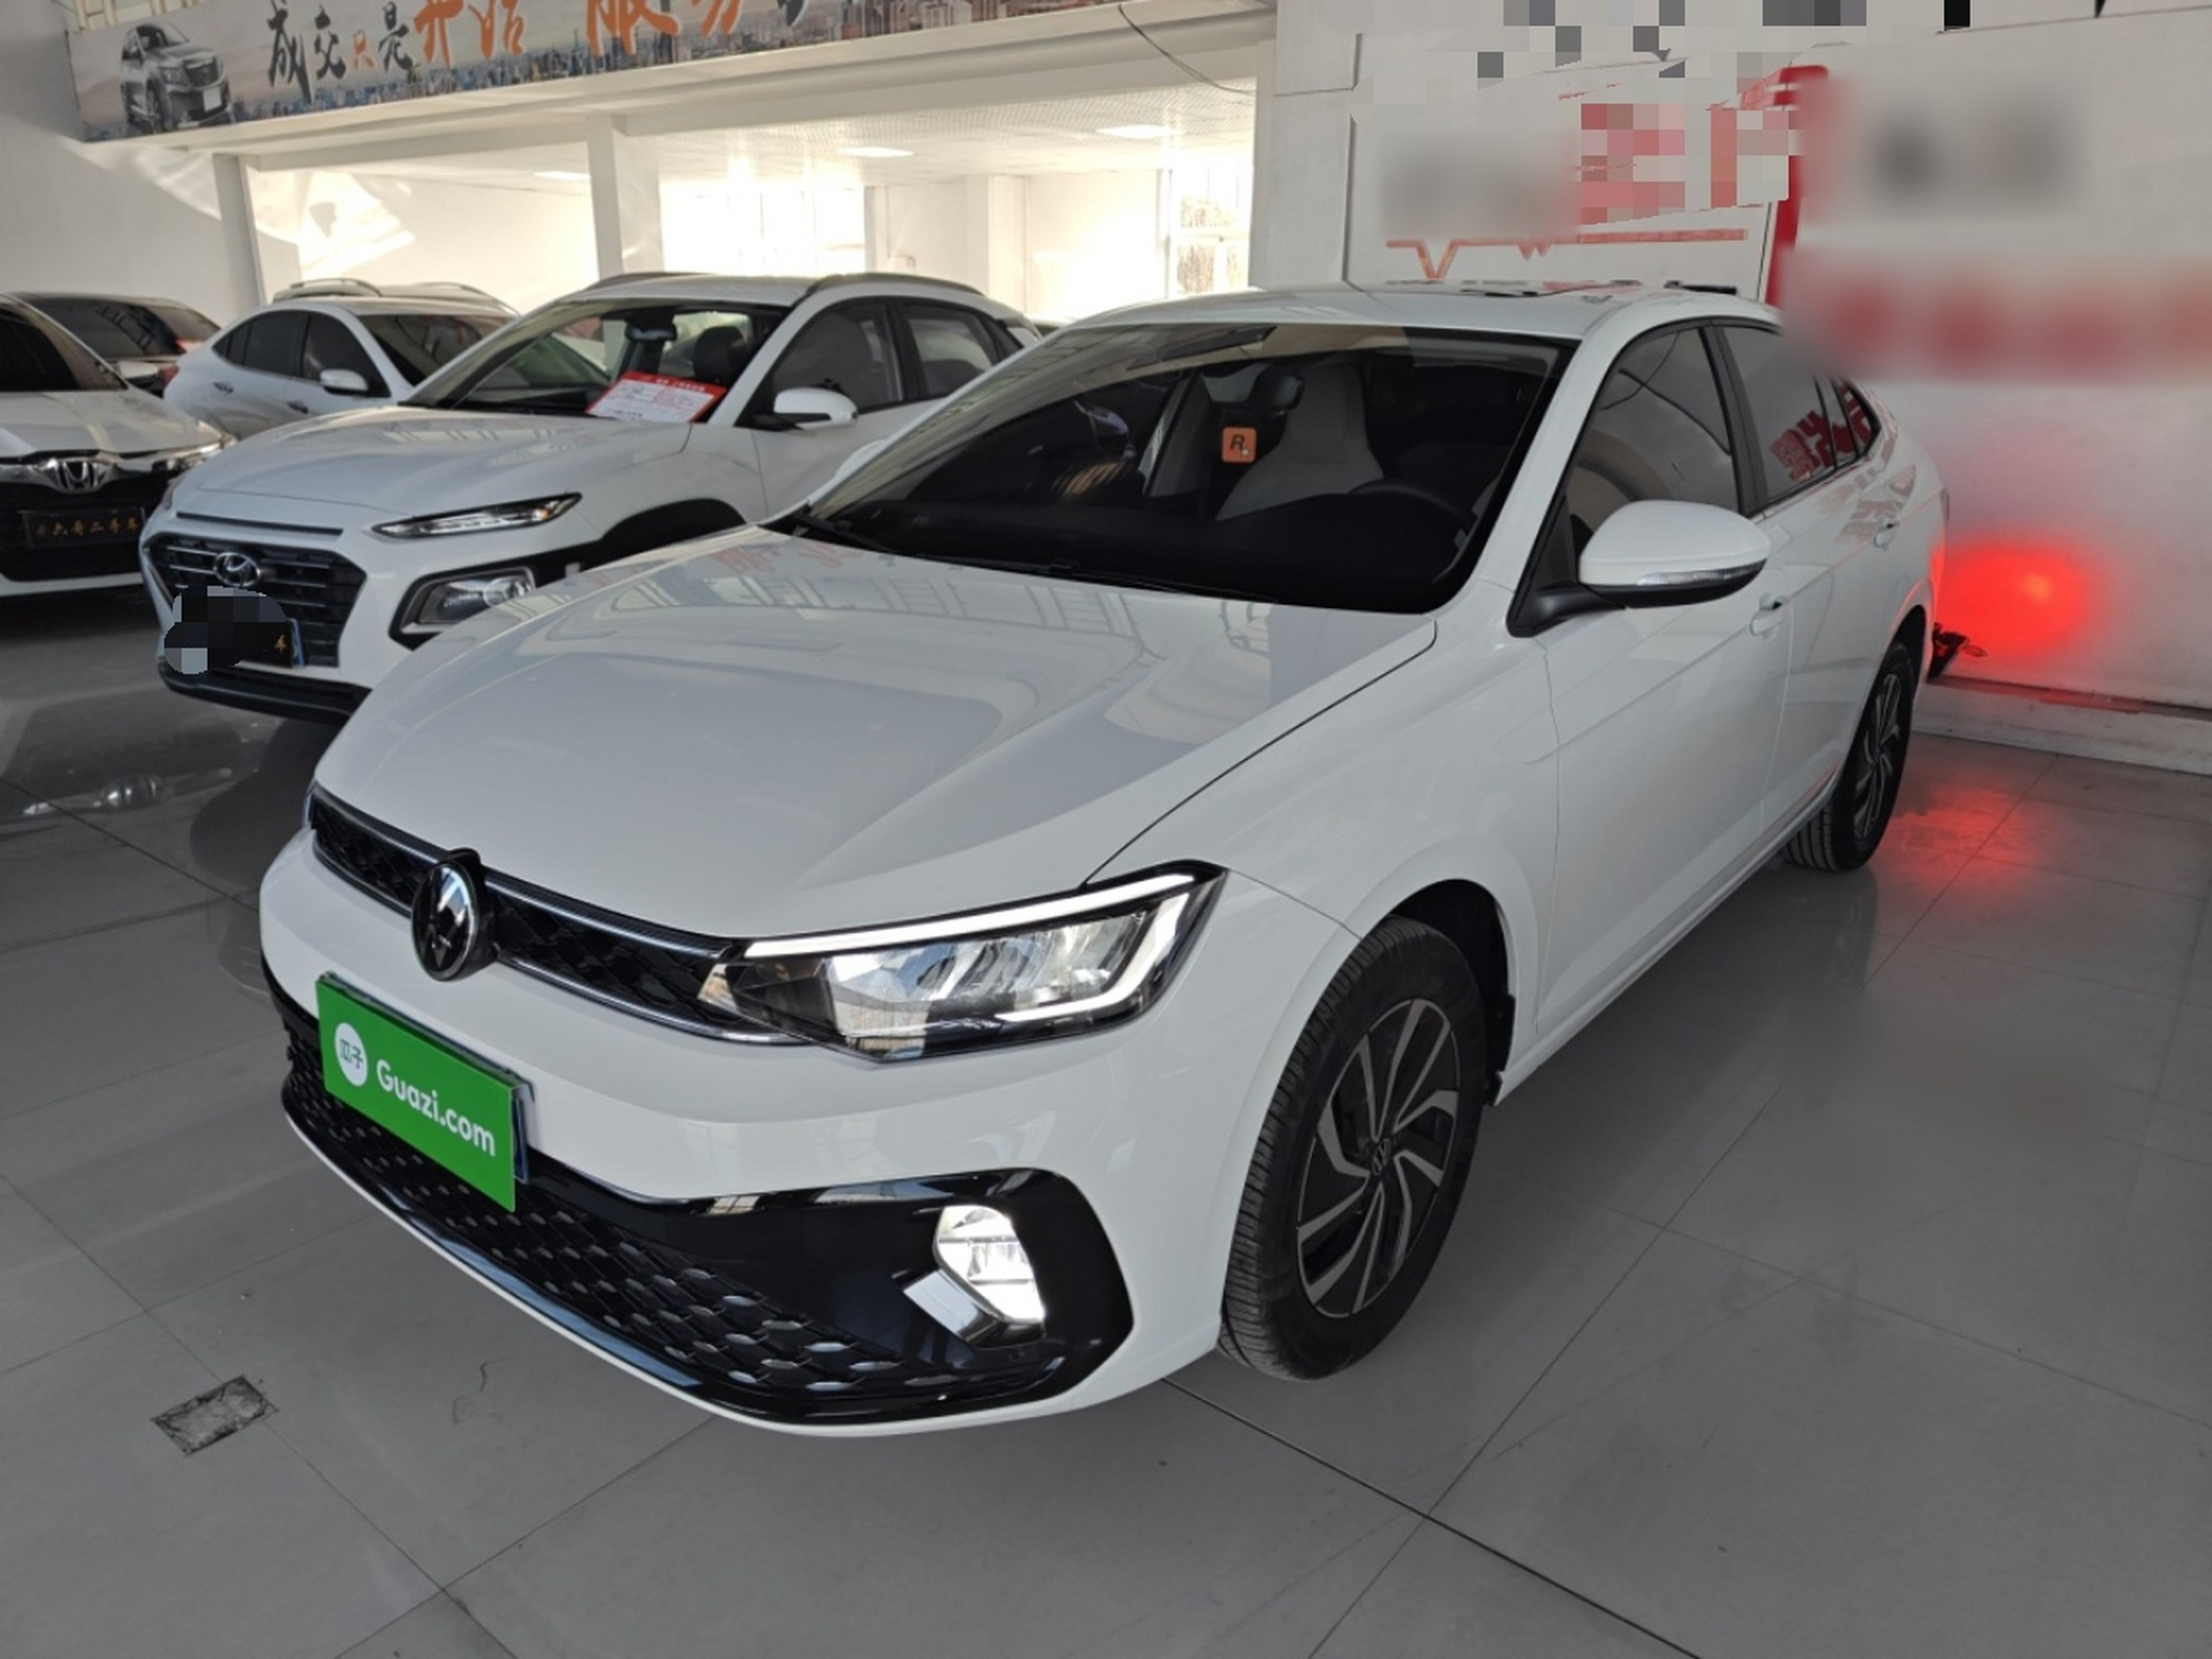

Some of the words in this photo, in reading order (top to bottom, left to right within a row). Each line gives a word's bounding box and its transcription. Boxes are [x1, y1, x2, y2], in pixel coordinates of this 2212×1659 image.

[1230, 434, 1245, 450] R
[339, 1038, 364, 1069] 瓜子
[376, 1059, 496, 1157] Guazi.com
